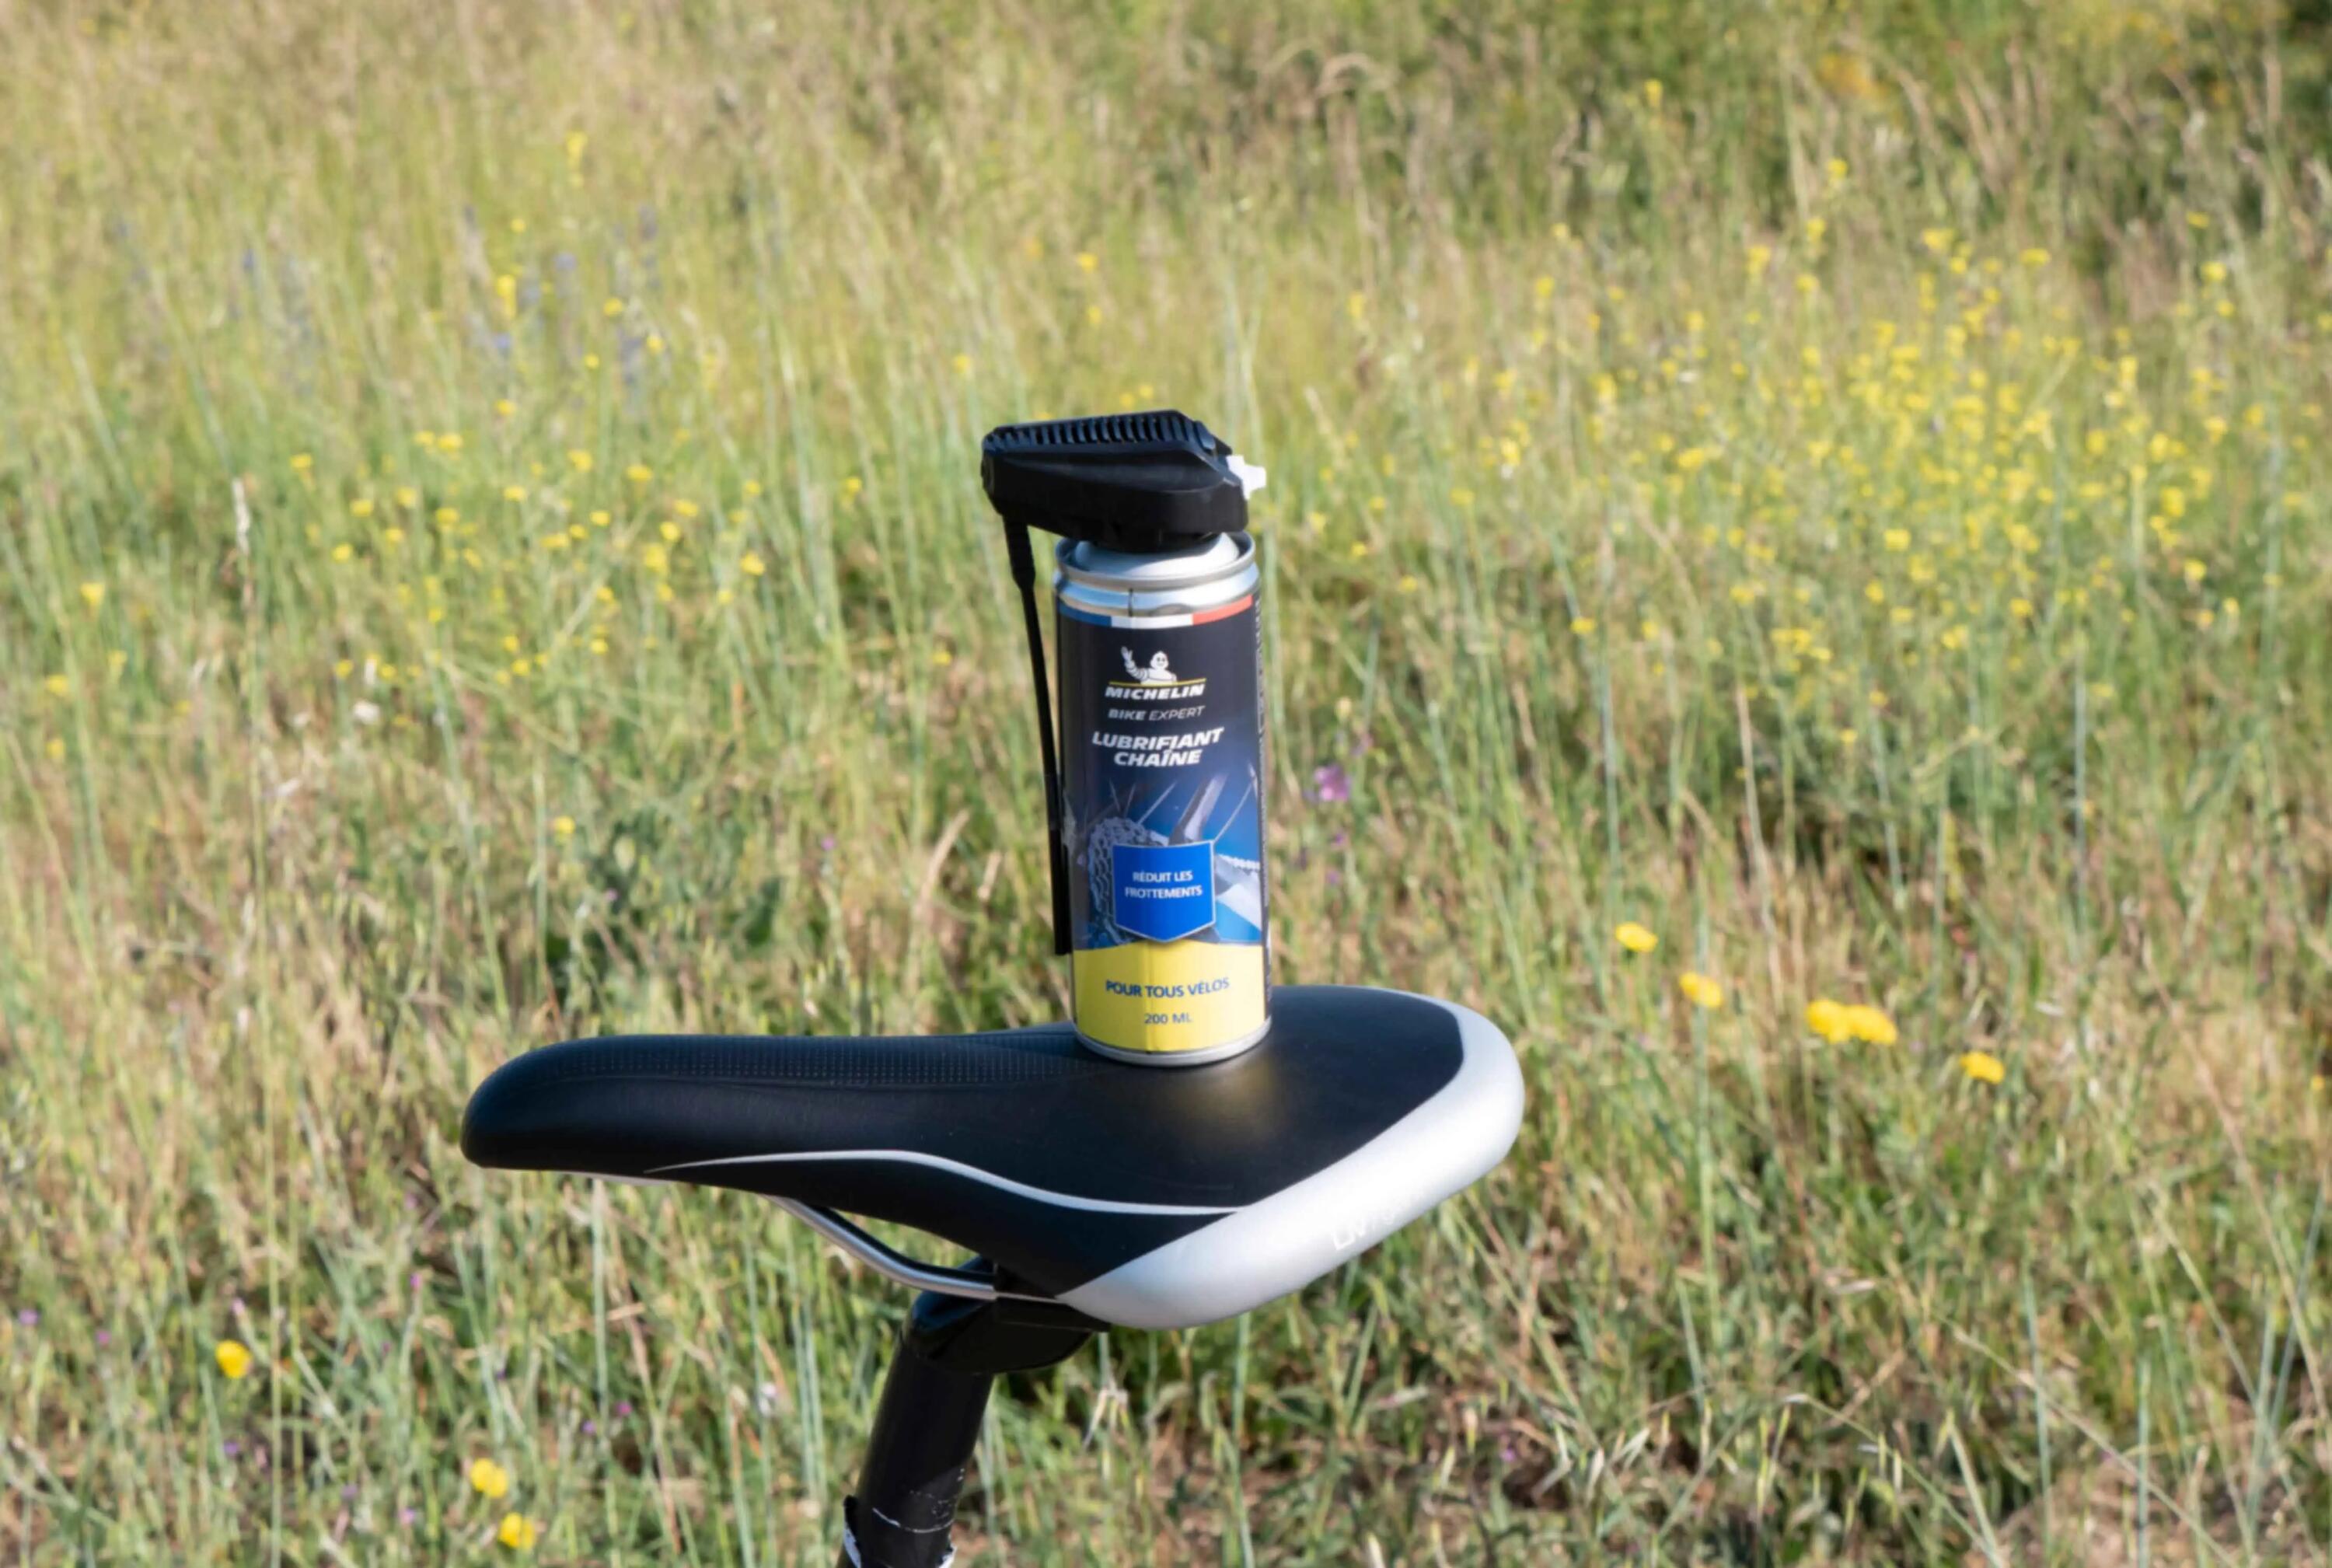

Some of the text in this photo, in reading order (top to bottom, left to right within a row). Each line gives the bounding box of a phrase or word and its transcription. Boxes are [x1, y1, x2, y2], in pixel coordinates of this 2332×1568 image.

[1105, 683, 1206, 700] MICHELIN
[1108, 705, 1206, 721] BIKE EXPERT
[1092, 727, 1224, 750] LUBRIFIANT
[1113, 747, 1203, 767] CHAÎNE
[1175, 870, 1193, 882] LES
[1125, 885, 1203, 899] FROTTEMENTS
[1105, 977, 1230, 998] POUR TOUS VÉLOS
[1144, 1012, 1191, 1025] 200 ML
